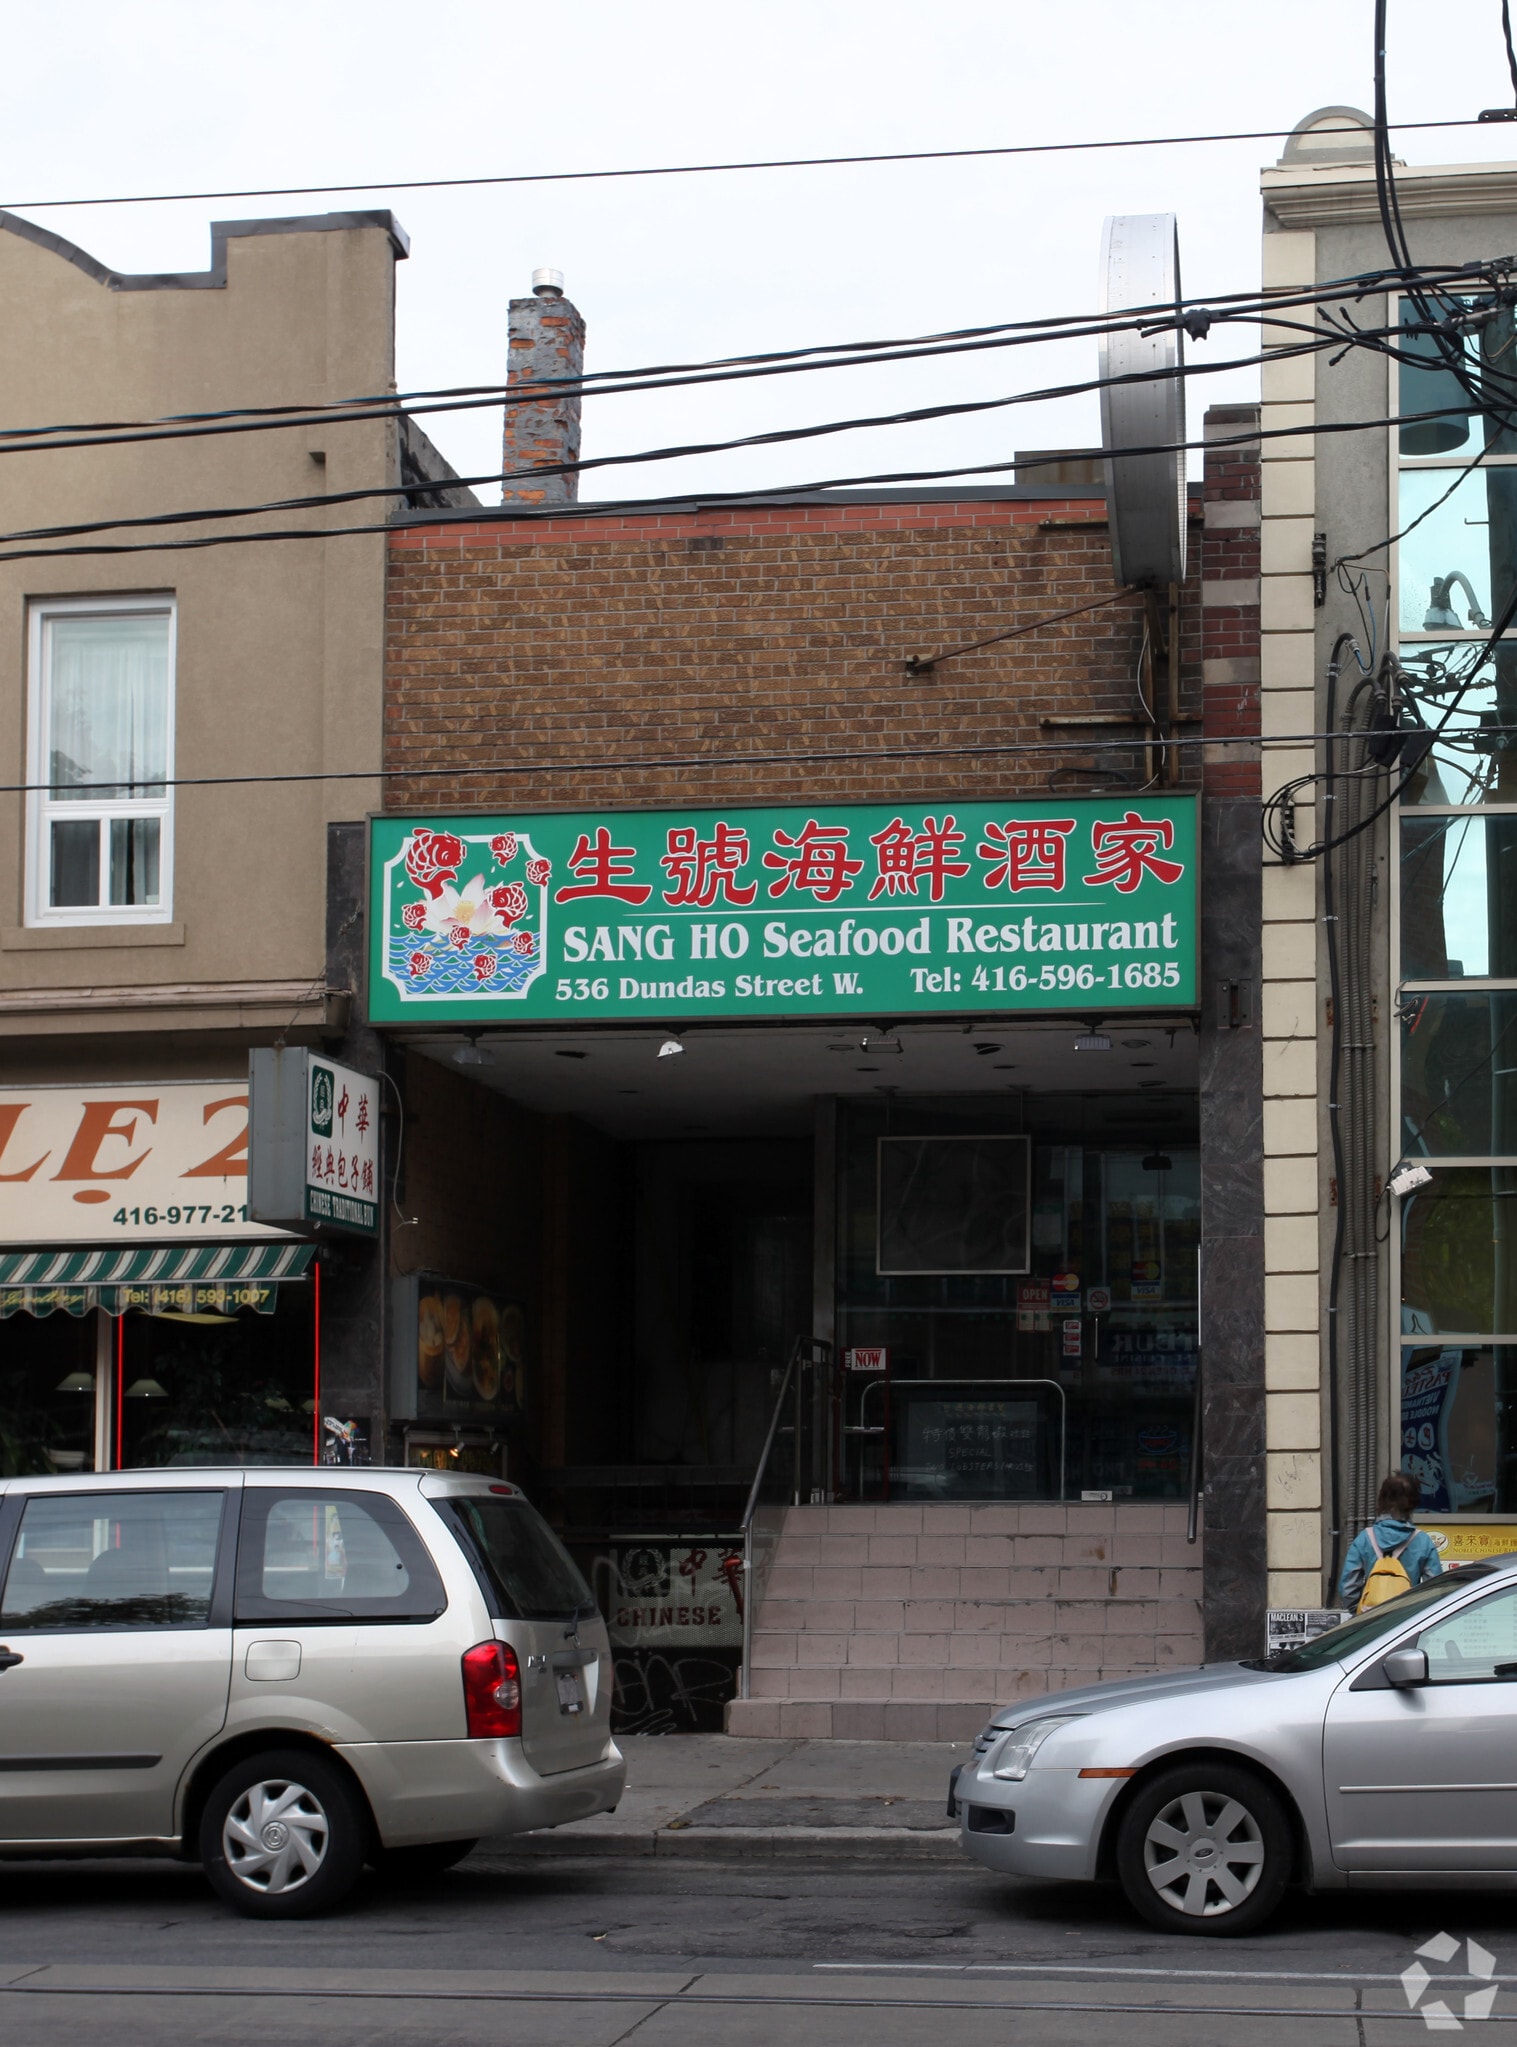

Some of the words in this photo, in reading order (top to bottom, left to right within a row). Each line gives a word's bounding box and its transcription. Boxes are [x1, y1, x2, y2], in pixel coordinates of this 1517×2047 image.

[554, 811, 1185, 908] 生號海鮮酒家
[563, 925, 675, 963] SANG
[689, 922, 749, 959] HO
[763, 917, 932, 958] Seafood
[947, 912, 1179, 953] Restaurant
[555, 978, 609, 1001] 536
[618, 975, 726, 1000] Dundas
[734, 972, 823, 998] Street
[833, 972, 864, 995] W.
[910, 966, 961, 993] Tel:
[971, 962, 1181, 991] 416-596-1685
[123, 1289, 149, 1304] Tel:
[1022, 1288, 1049, 1300] OPEN
[854, 1351, 882, 1367] NOW
[616, 1605, 722, 1627] CHINESE
